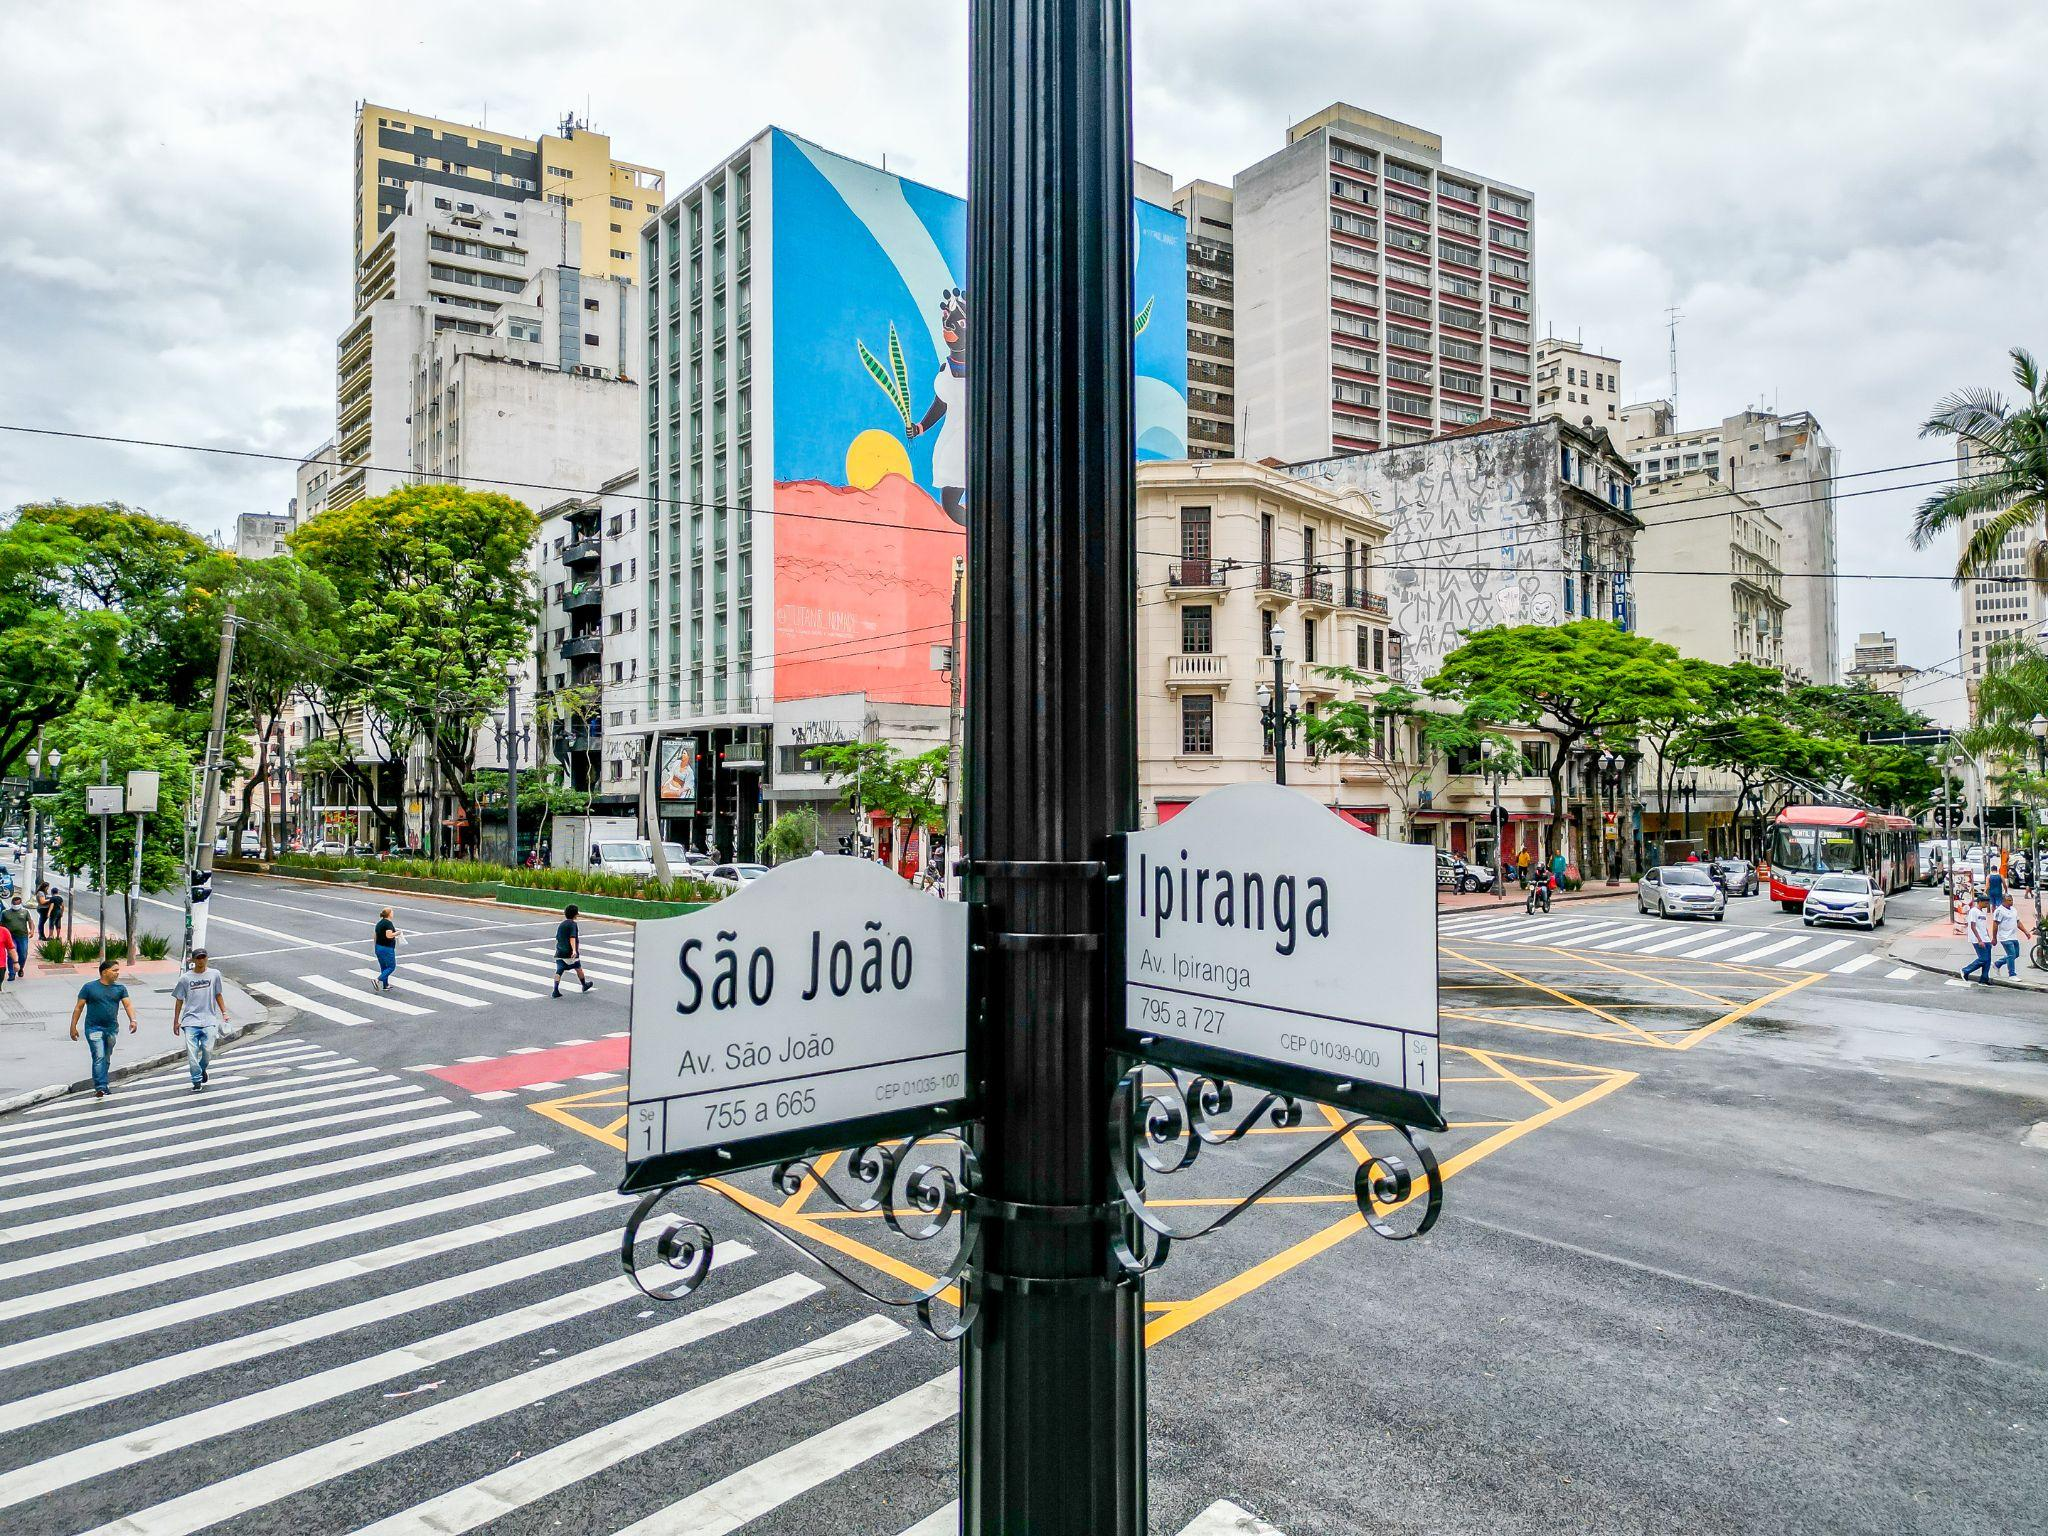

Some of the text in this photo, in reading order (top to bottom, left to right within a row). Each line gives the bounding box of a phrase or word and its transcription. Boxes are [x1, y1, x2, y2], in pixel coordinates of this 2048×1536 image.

[1139, 848, 1330, 956] Ipiranga
[676, 920, 913, 1014] São João
[1140, 948, 1251, 992] Av. Ipiranga
[1140, 997, 1226, 1035] 795 a 727
[677, 1032, 835, 1078] Av. São João
[1280, 1033, 1380, 1068] CEP 01039-000
[875, 1074, 960, 1101] CEP 01035-100
[1416, 1058, 1425, 1086] 1
[704, 1087, 816, 1132] 755 a 665
[643, 1125, 651, 1152] 1
